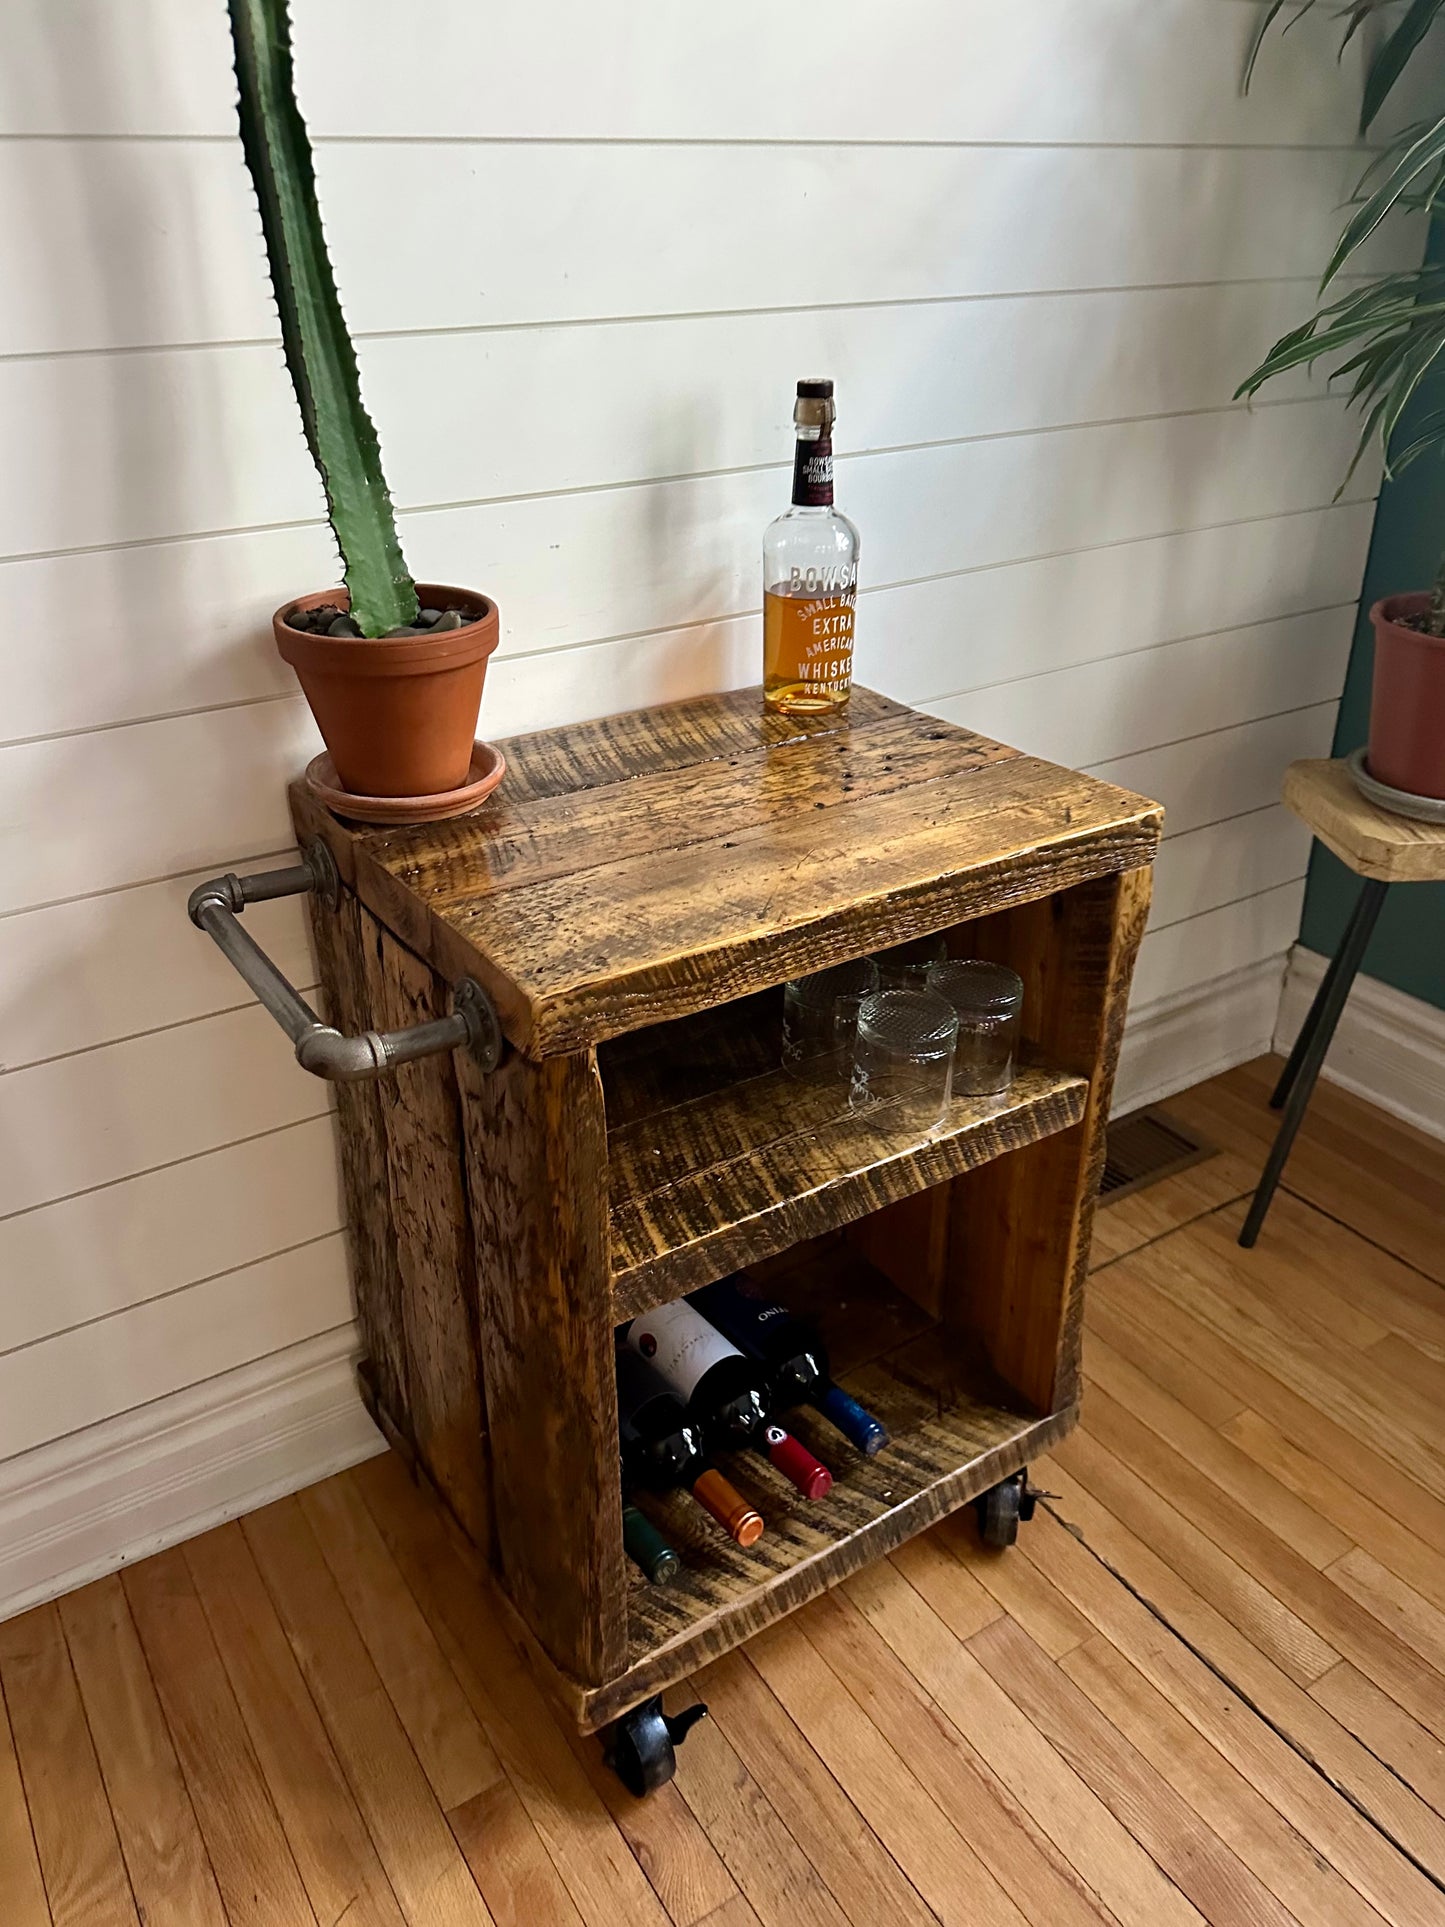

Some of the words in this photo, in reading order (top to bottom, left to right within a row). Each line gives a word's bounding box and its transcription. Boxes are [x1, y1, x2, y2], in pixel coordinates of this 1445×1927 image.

[802, 464, 824, 474] SMALL
[797, 595, 836, 621] SMALL
[813, 614, 852, 635] EXTRA
